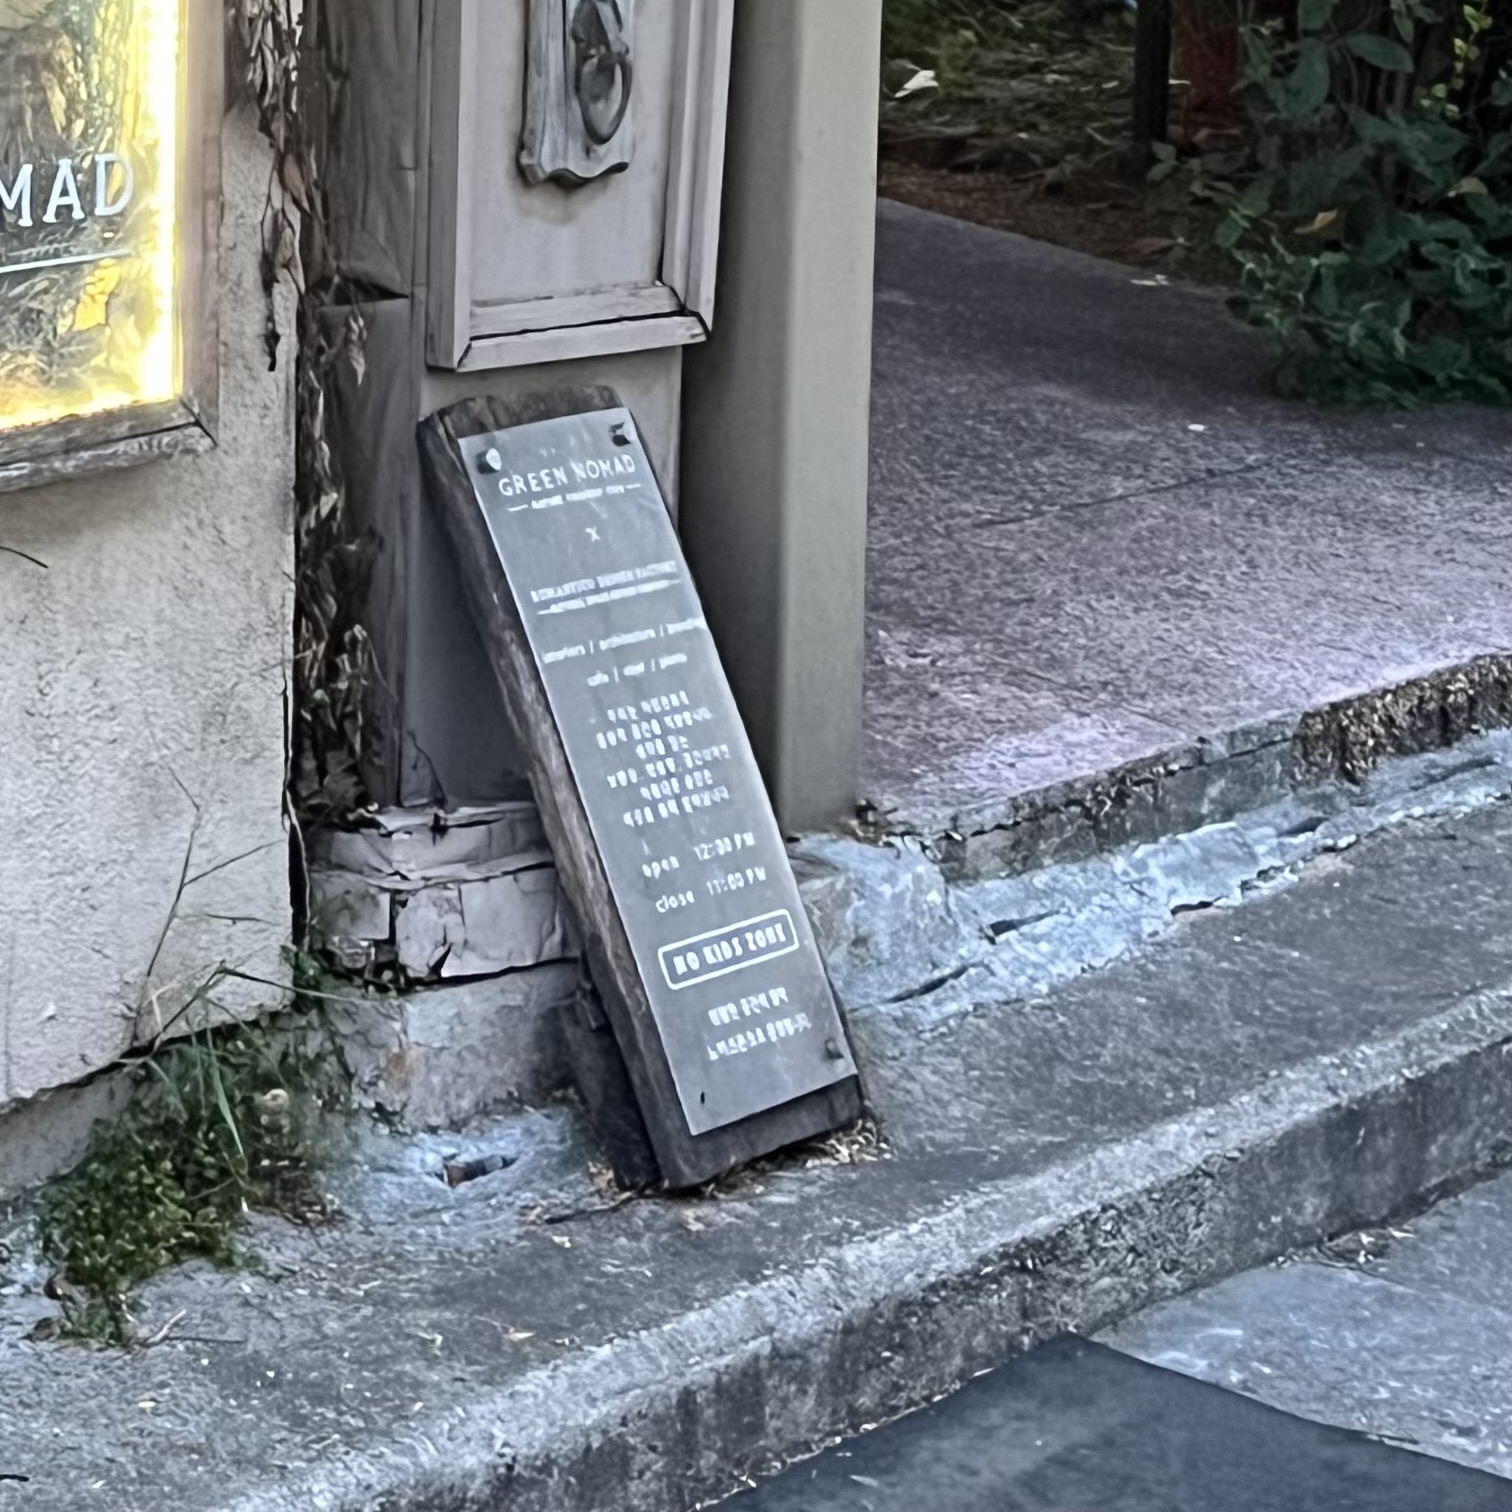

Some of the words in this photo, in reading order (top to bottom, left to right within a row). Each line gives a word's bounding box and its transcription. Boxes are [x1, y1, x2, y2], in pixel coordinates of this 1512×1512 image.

[498, 466, 568, 497] GREEN
[569, 454, 636, 483] NOMAD
[641, 855, 680, 880] open
[655, 890, 695, 913] close
[672, 951, 700, 976] NO
[702, 936, 743, 965] KIDS
[744, 922, 787, 951] ZONE
